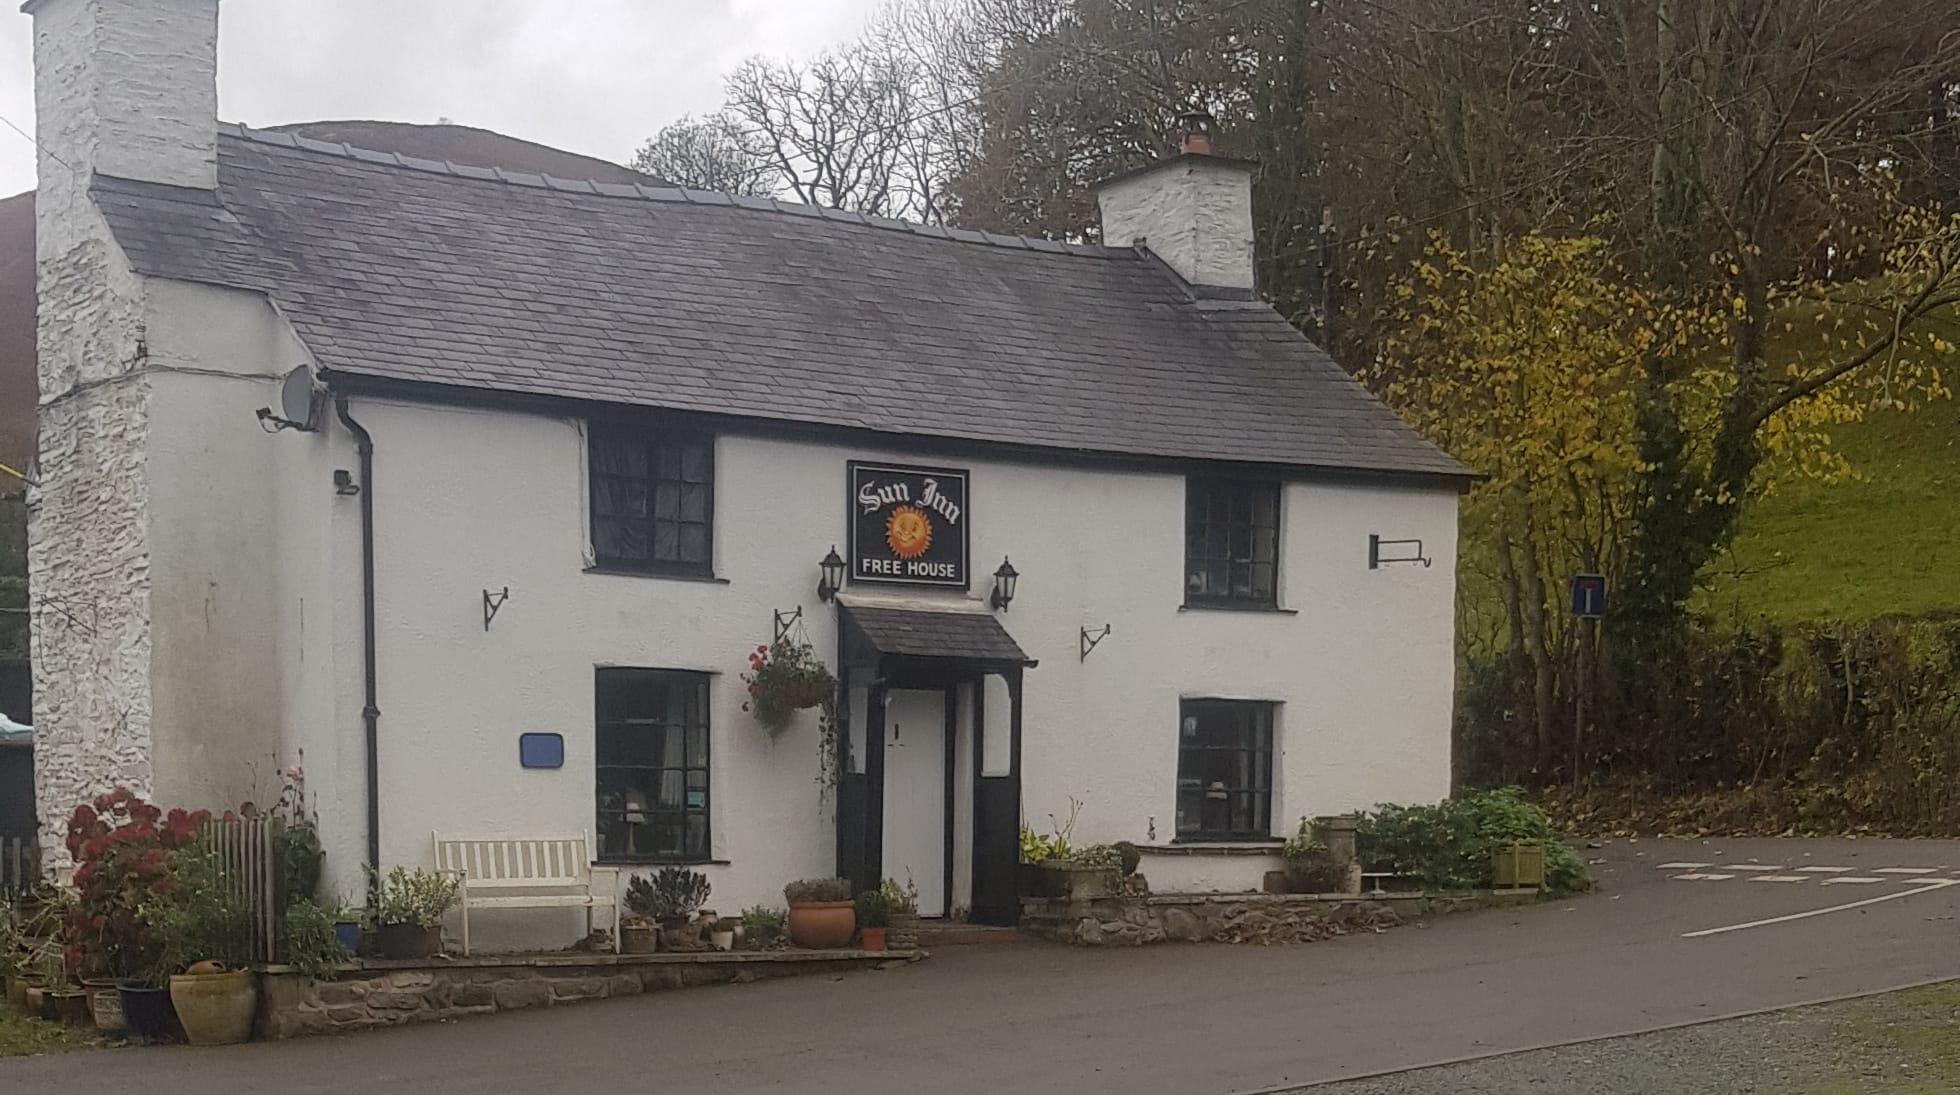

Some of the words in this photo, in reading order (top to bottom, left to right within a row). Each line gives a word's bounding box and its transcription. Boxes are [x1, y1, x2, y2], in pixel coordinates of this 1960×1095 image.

[858, 480, 910, 515] Sun
[915, 478, 960, 525] Inn
[862, 558, 902, 575] FREE
[907, 561, 956, 578] HOUSE
